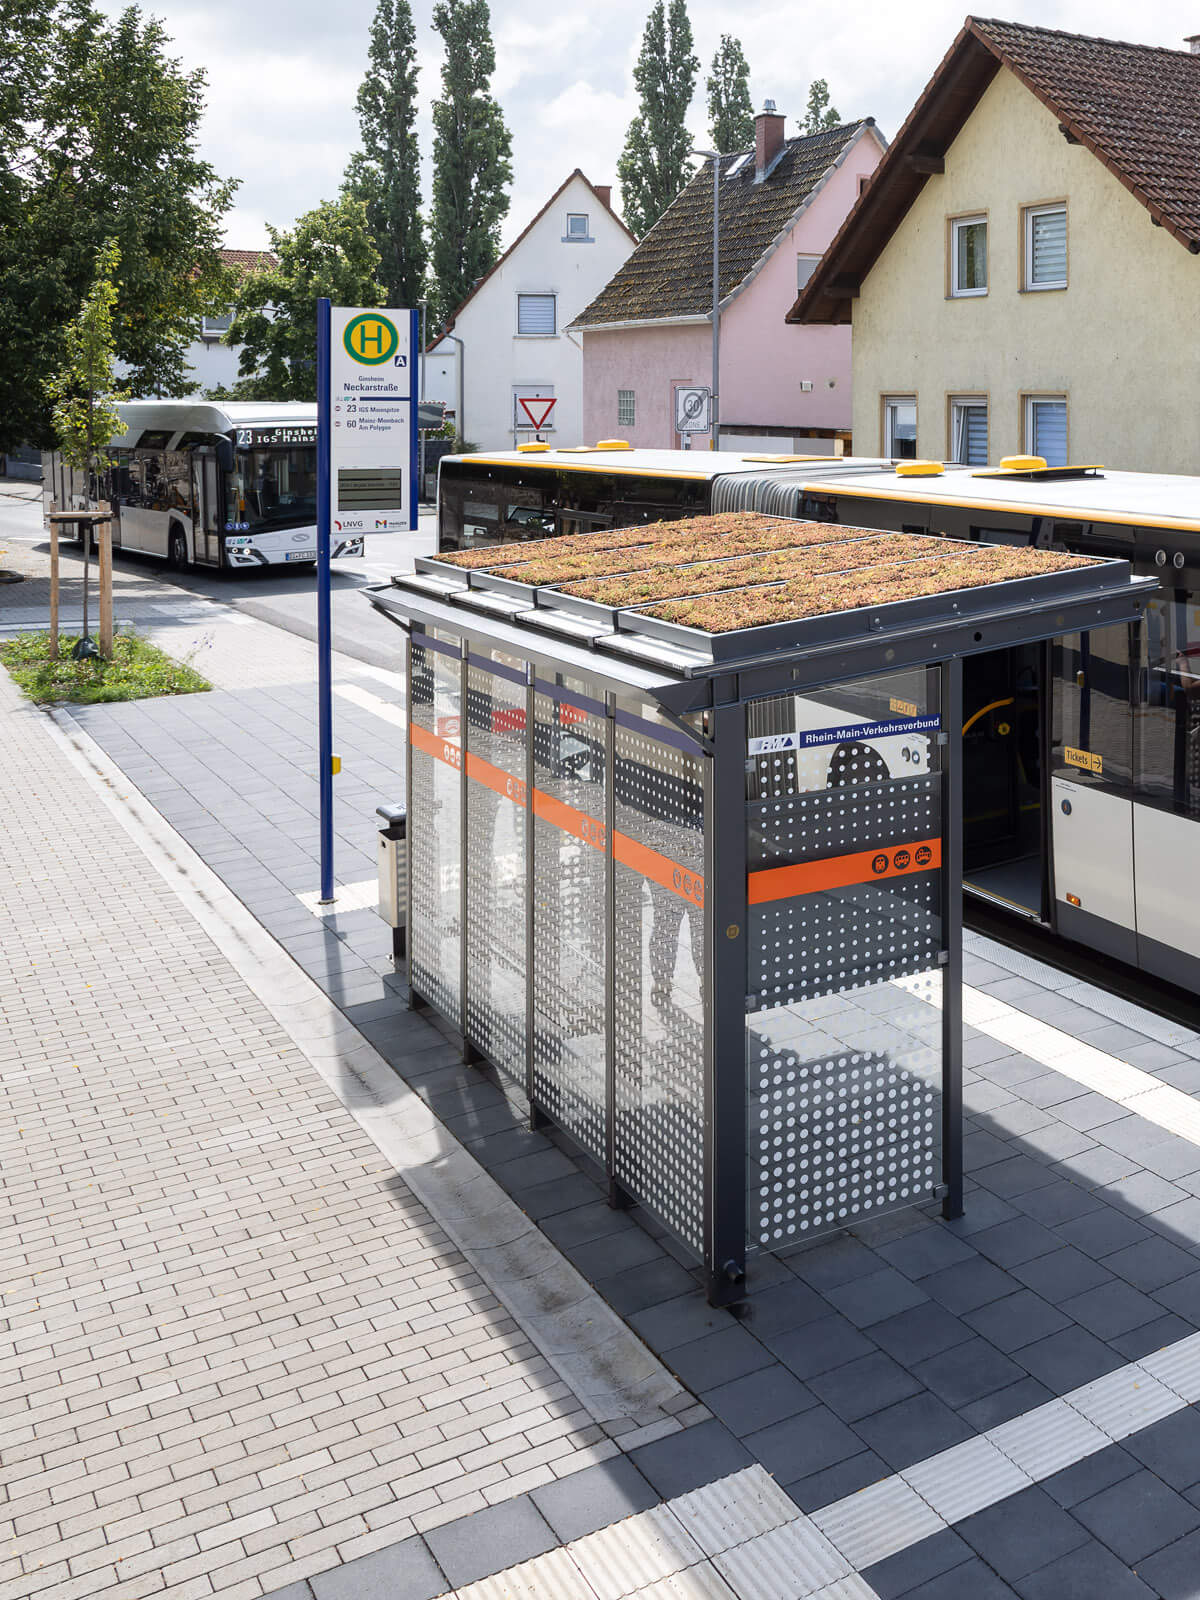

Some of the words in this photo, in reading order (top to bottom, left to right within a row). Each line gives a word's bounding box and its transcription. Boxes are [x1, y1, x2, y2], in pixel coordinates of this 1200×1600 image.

[360, 324, 382, 354] H
[395, 356, 406, 367] A
[343, 382, 399, 392] Neckarstraße
[346, 404, 357, 413] 23
[687, 399, 700, 412] 30
[346, 419, 357, 429] 60
[369, 424, 392, 432] Polygon
[237, 429, 253, 445] 23
[274, 427, 318, 436] Ginshei
[256, 434, 278, 443] IGS
[282, 434, 318, 443] Mains
[342, 520, 364, 528] LNVG
[805, 716, 940, 744] Rhein-Main-Verkehrsverbund
[1066, 749, 1088, 766] Tickets
